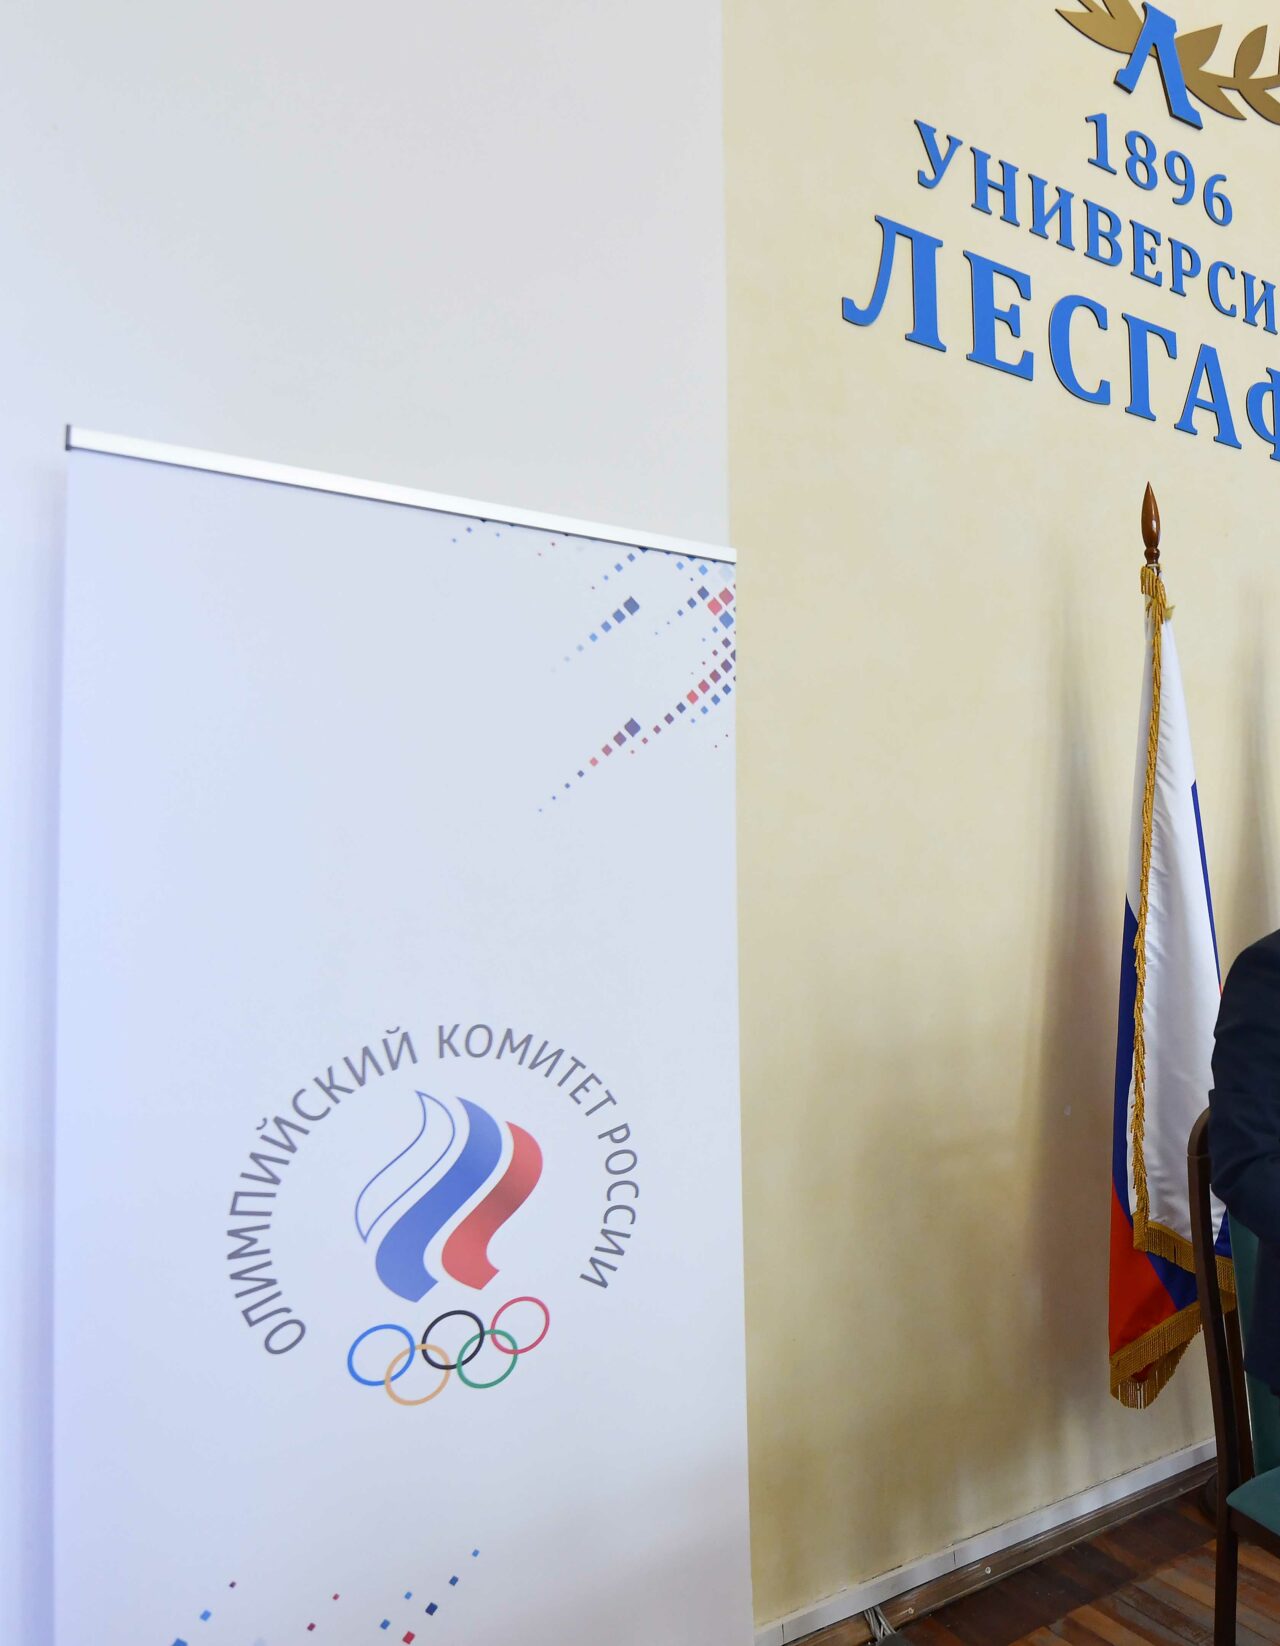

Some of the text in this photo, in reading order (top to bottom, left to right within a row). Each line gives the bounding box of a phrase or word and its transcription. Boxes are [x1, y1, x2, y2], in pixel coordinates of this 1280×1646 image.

[1085, 112, 1234, 227] 1896
[226, 1023, 640, 1355] ОЛИМПИЙСКИЙ КОМИТЕТ РОССИИ
